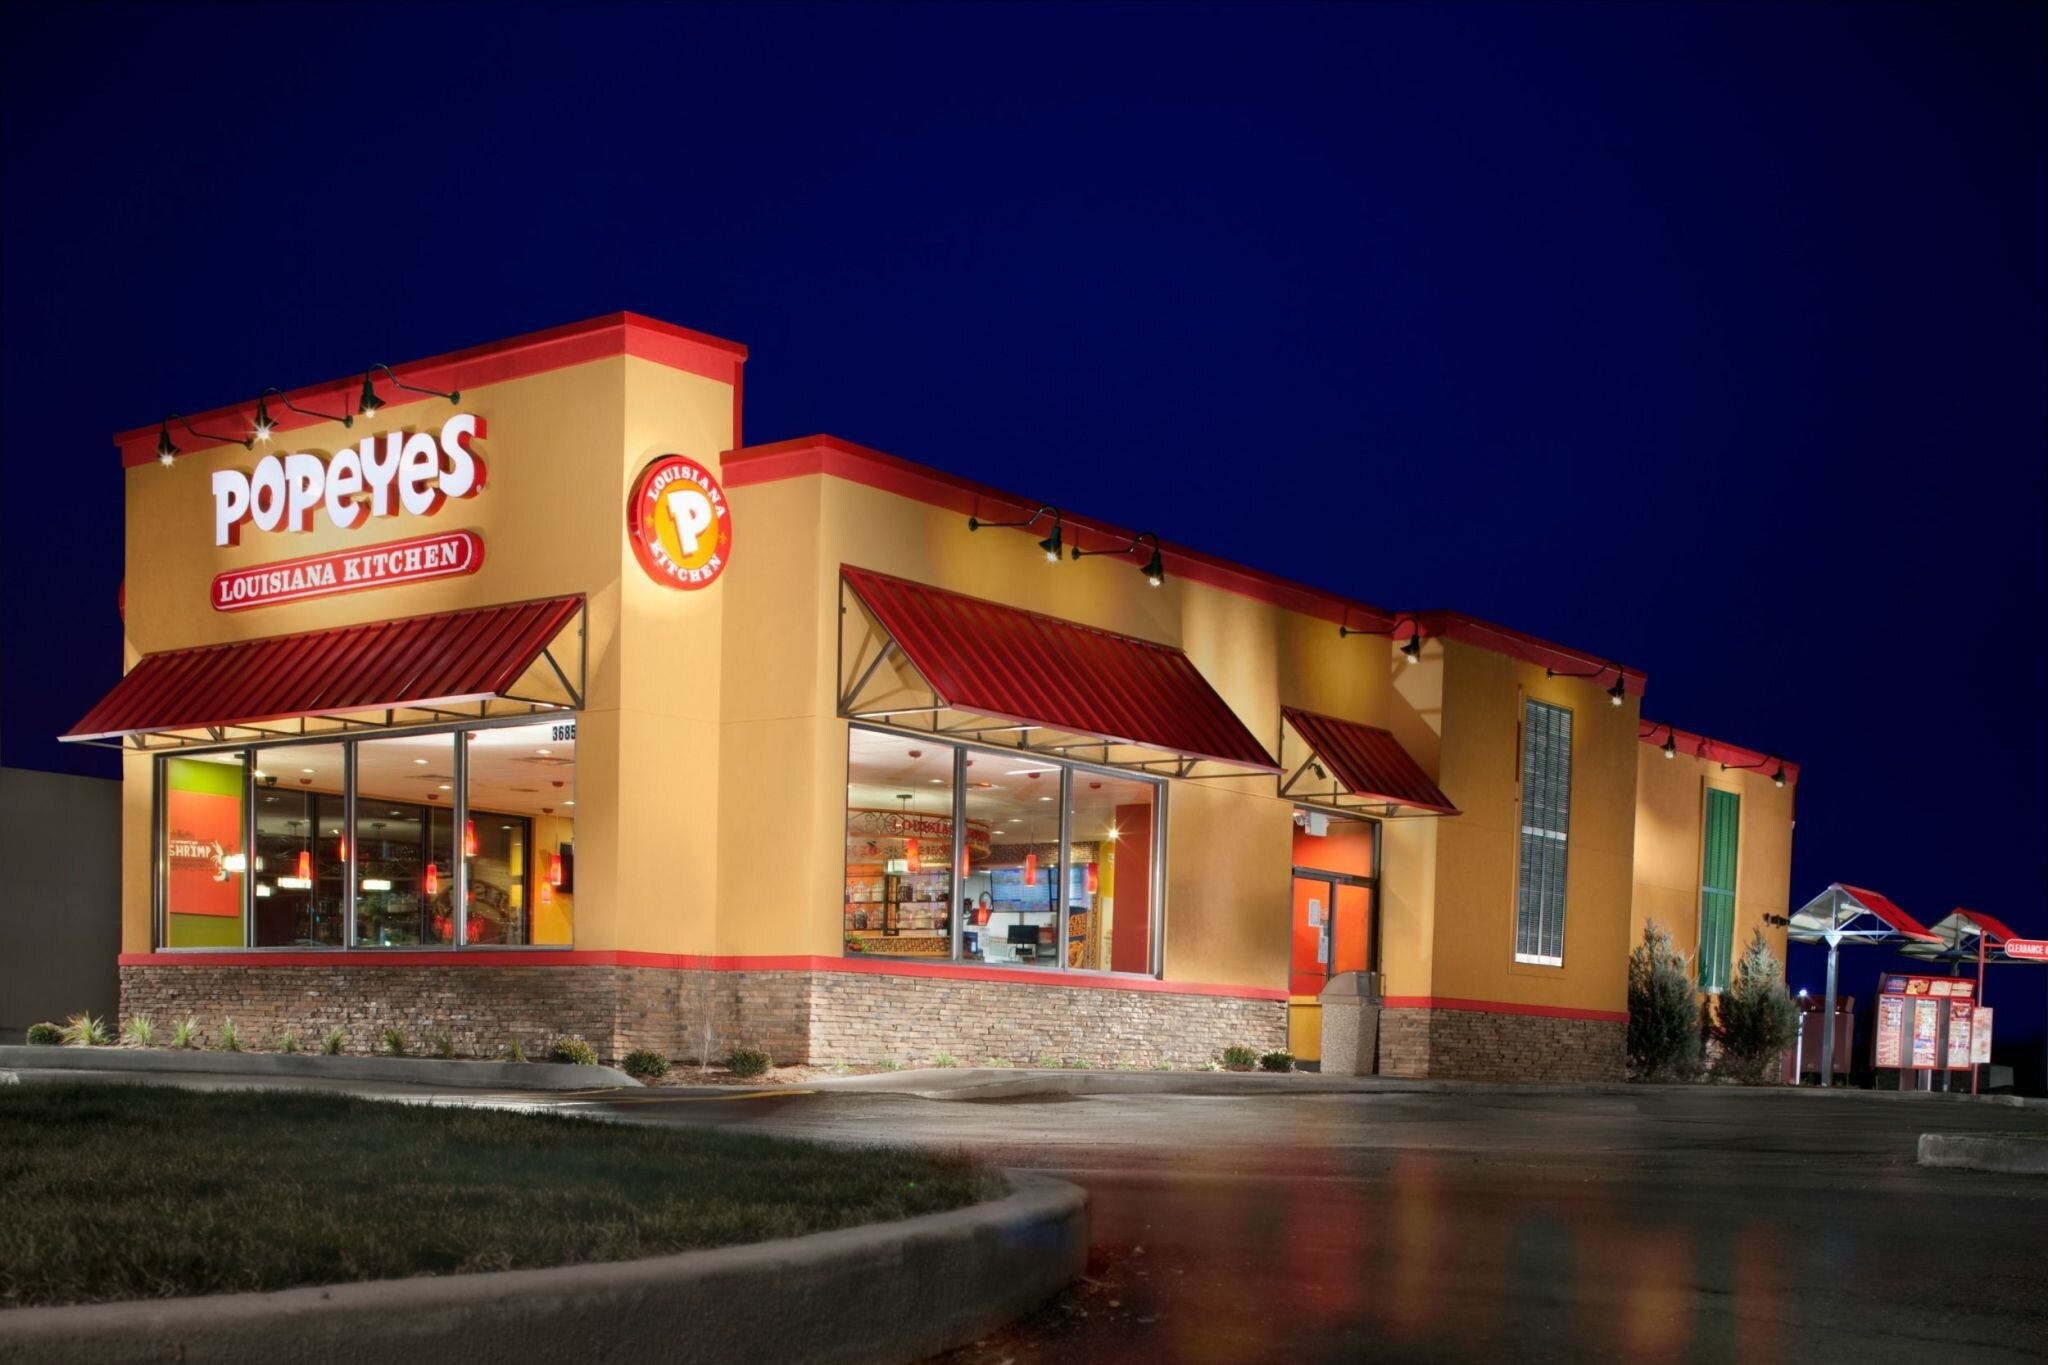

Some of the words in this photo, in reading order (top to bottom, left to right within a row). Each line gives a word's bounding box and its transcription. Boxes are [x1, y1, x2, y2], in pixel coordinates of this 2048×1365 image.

[648, 466, 726, 518] LOUISIANA
[667, 490, 712, 555] P
[220, 562, 336, 603] LOUISIANA
[343, 541, 459, 582] KITCHEN
[650, 540, 721, 583] KITCHEN
[552, 725, 576, 741] 3685
[168, 844, 212, 858] SHRIMP
[2007, 943, 2044, 955] CLEARANCE
